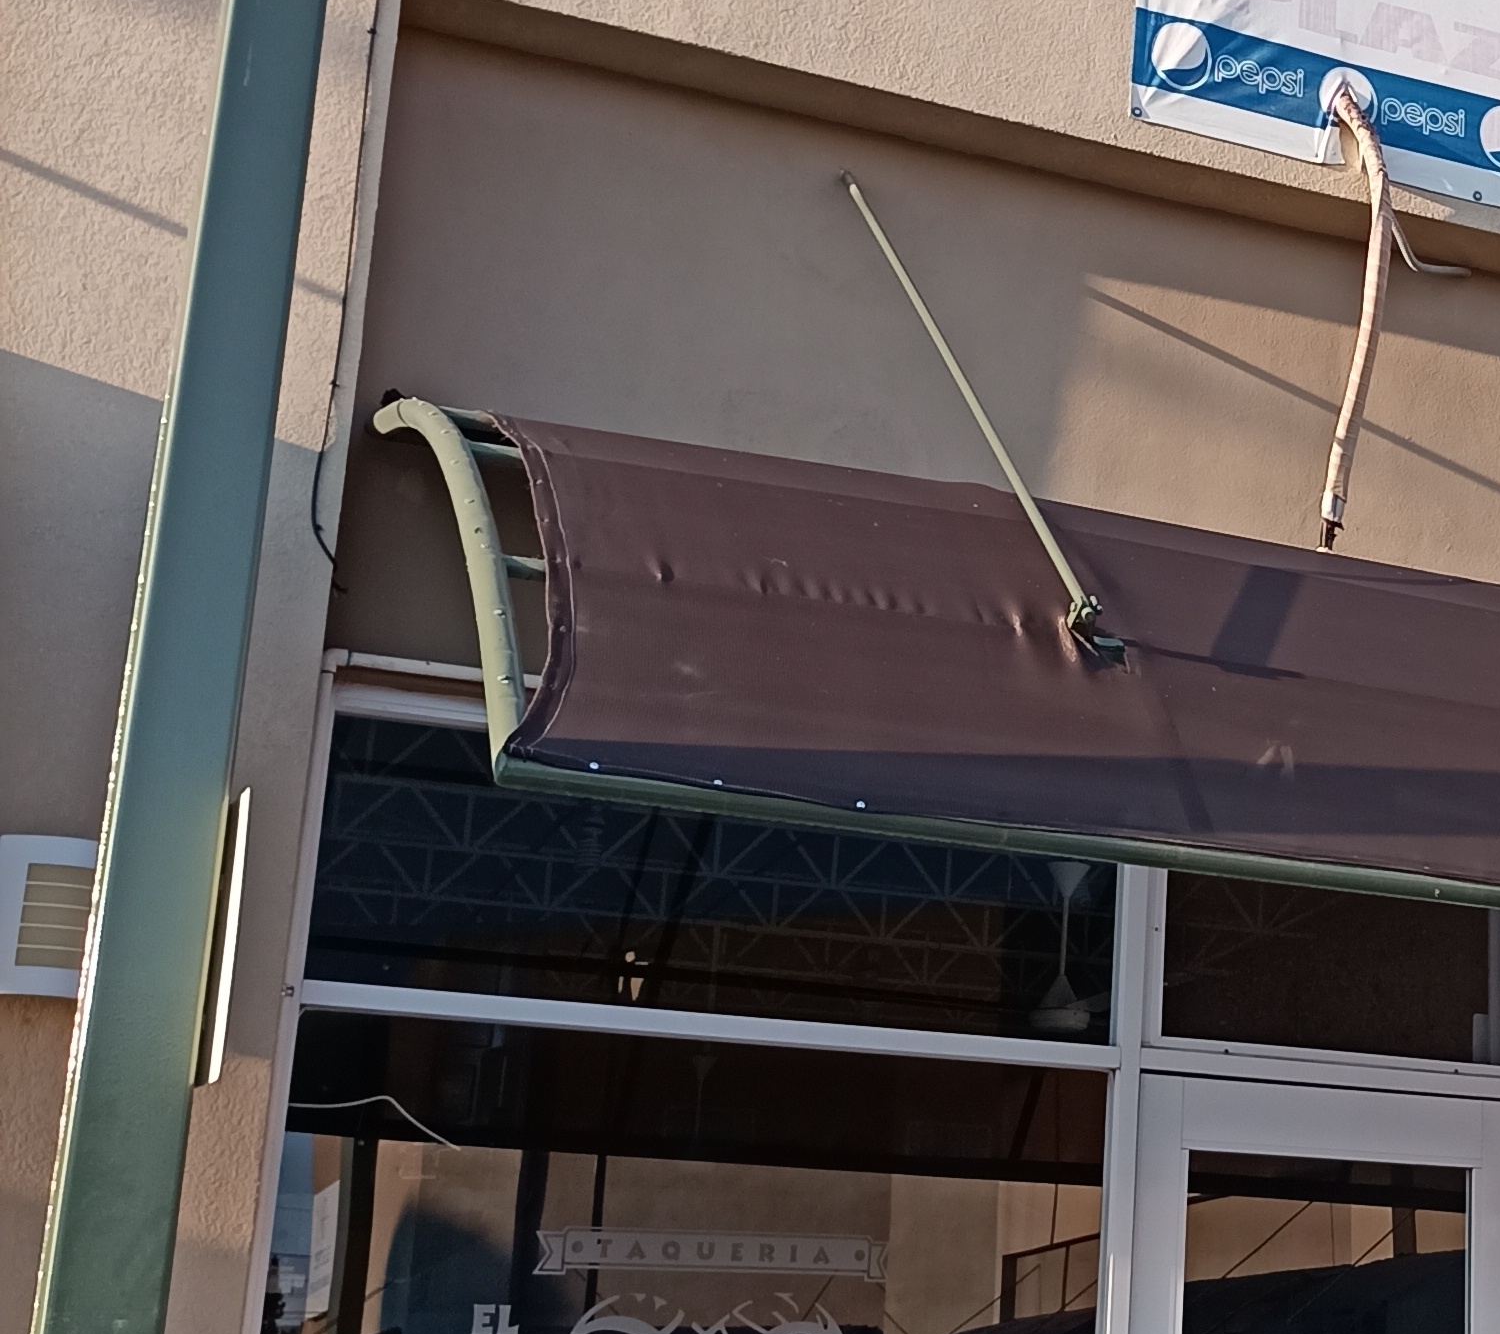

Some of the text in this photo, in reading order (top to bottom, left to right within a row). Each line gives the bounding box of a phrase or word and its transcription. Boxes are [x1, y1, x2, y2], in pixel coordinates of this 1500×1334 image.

[1214, 54, 1305, 99] pepsi
[1381, 97, 1465, 139] pepsi
[597, 1237, 832, 1265] TAQUERIA
